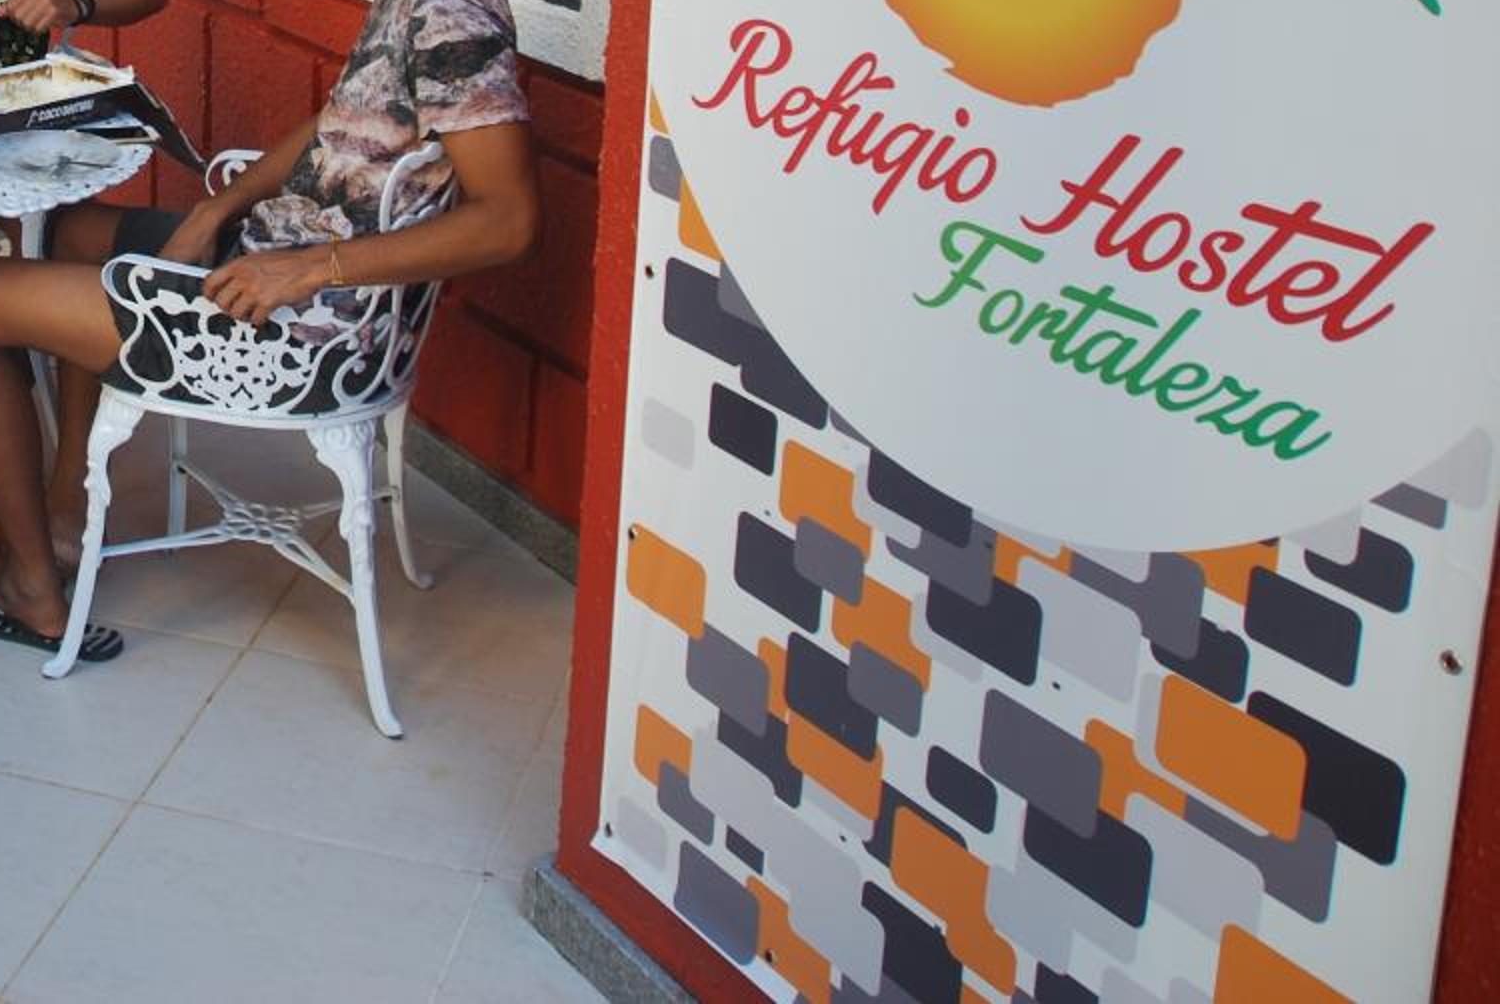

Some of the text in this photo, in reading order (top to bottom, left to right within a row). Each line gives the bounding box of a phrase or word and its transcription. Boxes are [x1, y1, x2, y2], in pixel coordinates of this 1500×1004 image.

[691, 18, 1436, 343] Refúgio Hostel
[912, 221, 1333, 462] Fortaleza
